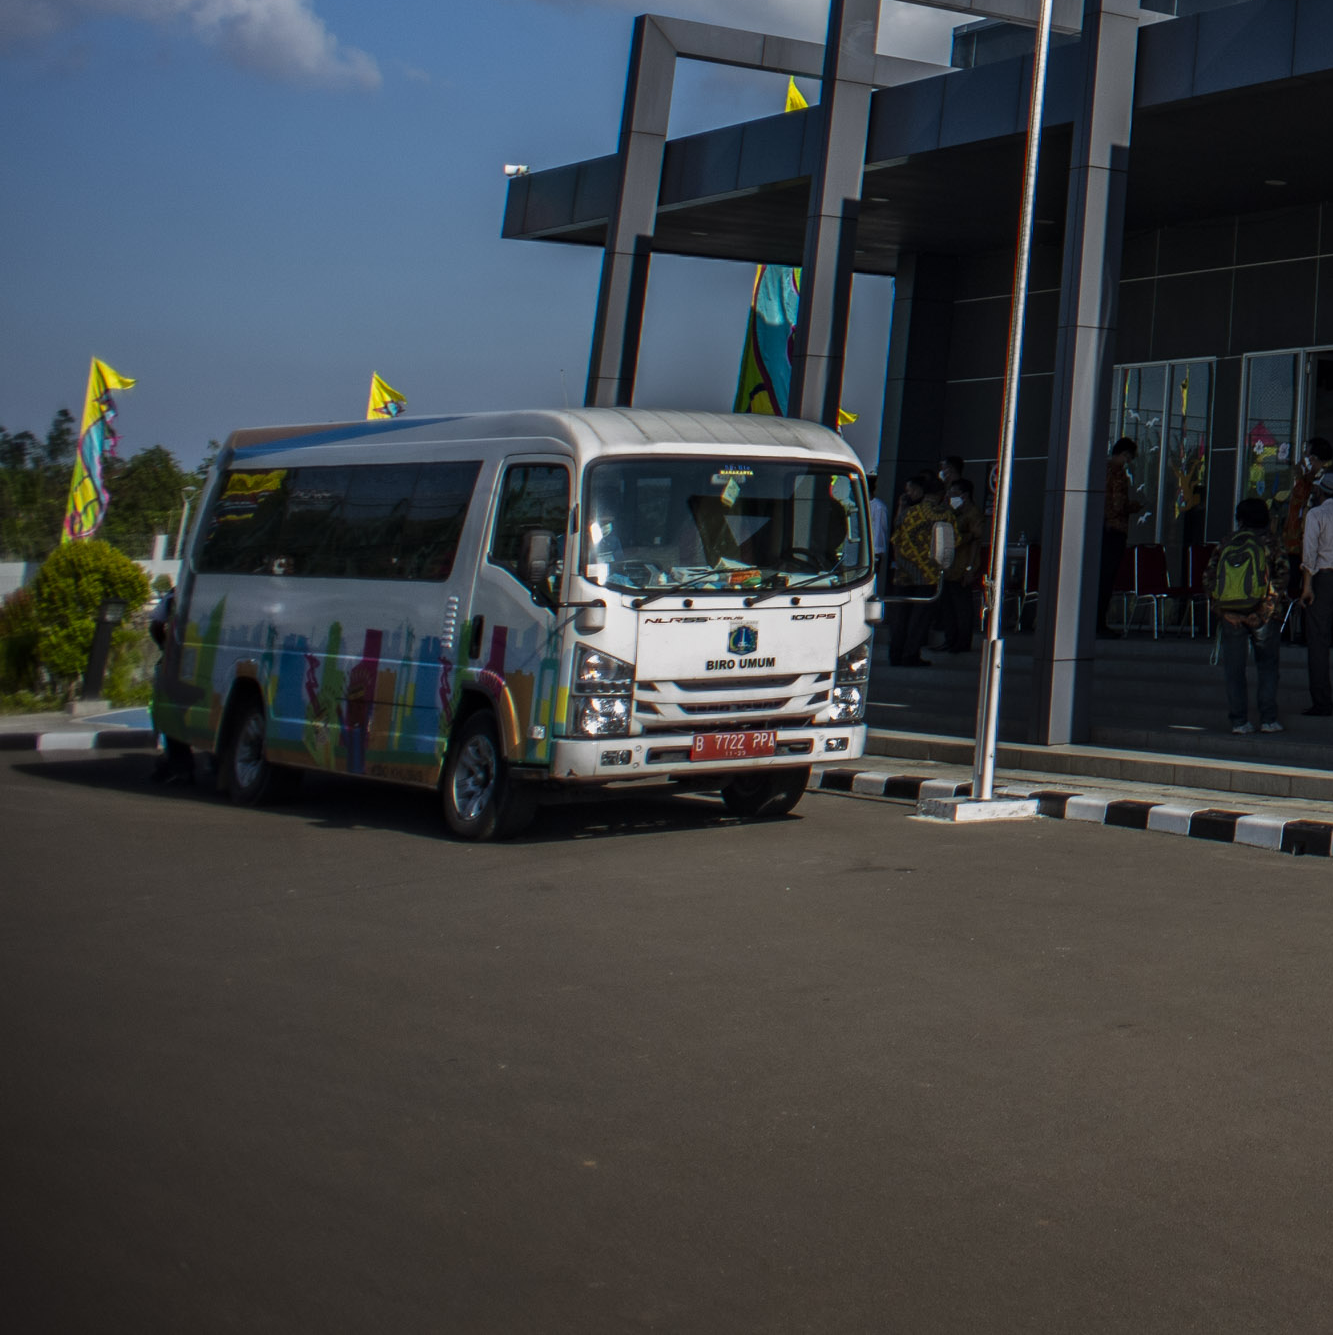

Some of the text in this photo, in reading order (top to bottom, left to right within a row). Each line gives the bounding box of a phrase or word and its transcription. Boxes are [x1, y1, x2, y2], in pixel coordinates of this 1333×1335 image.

[706, 657, 776, 671] BIRO UMUM
[696, 732, 775, 752] B 7722 PPA
